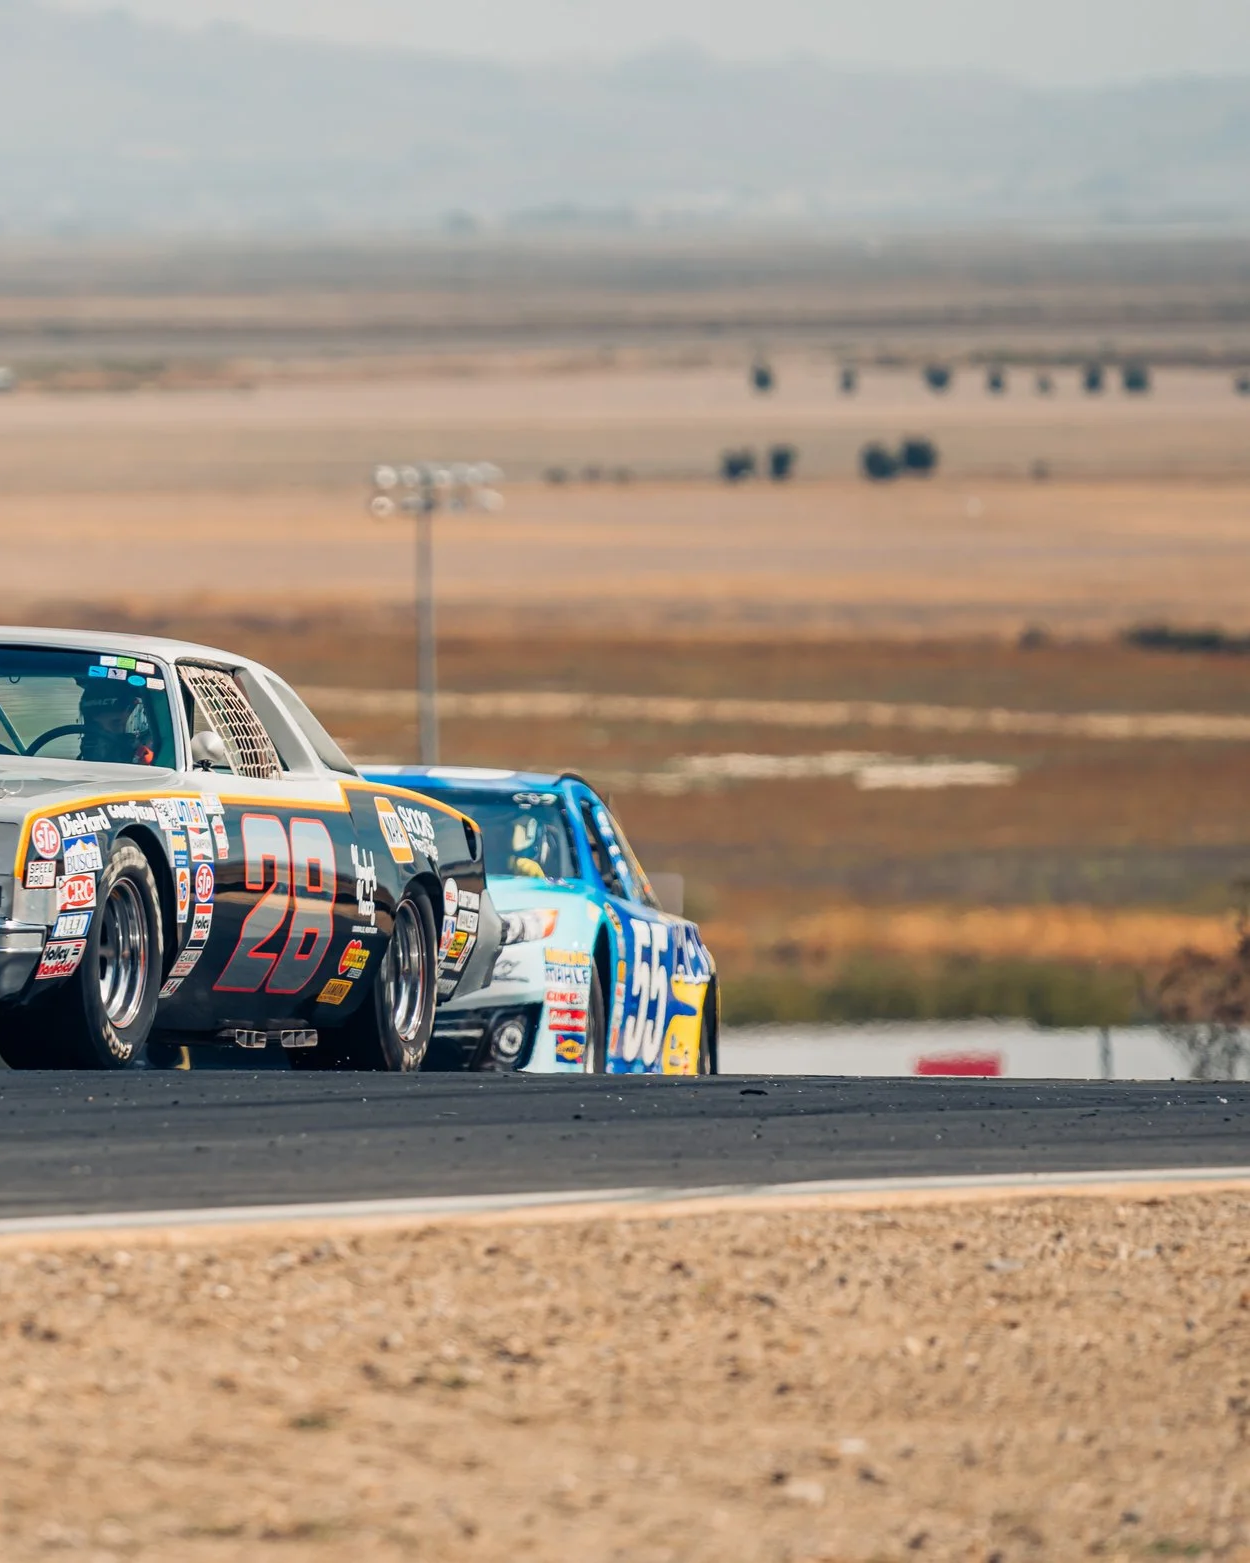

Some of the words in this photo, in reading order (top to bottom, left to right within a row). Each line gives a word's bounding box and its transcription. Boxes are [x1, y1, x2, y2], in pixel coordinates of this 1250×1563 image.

[34, 822, 58, 852] STP
[58, 807, 111, 838] DieHard
[381, 813, 408, 843] NAPA
[30, 863, 53, 874] SPEED
[66, 851, 99, 874] BUSCH
[29, 875, 44, 885] PRO
[66, 878, 96, 903] CRC
[197, 867, 211, 896] STP
[212, 813, 337, 994] 28
[622, 917, 669, 1067] 55
